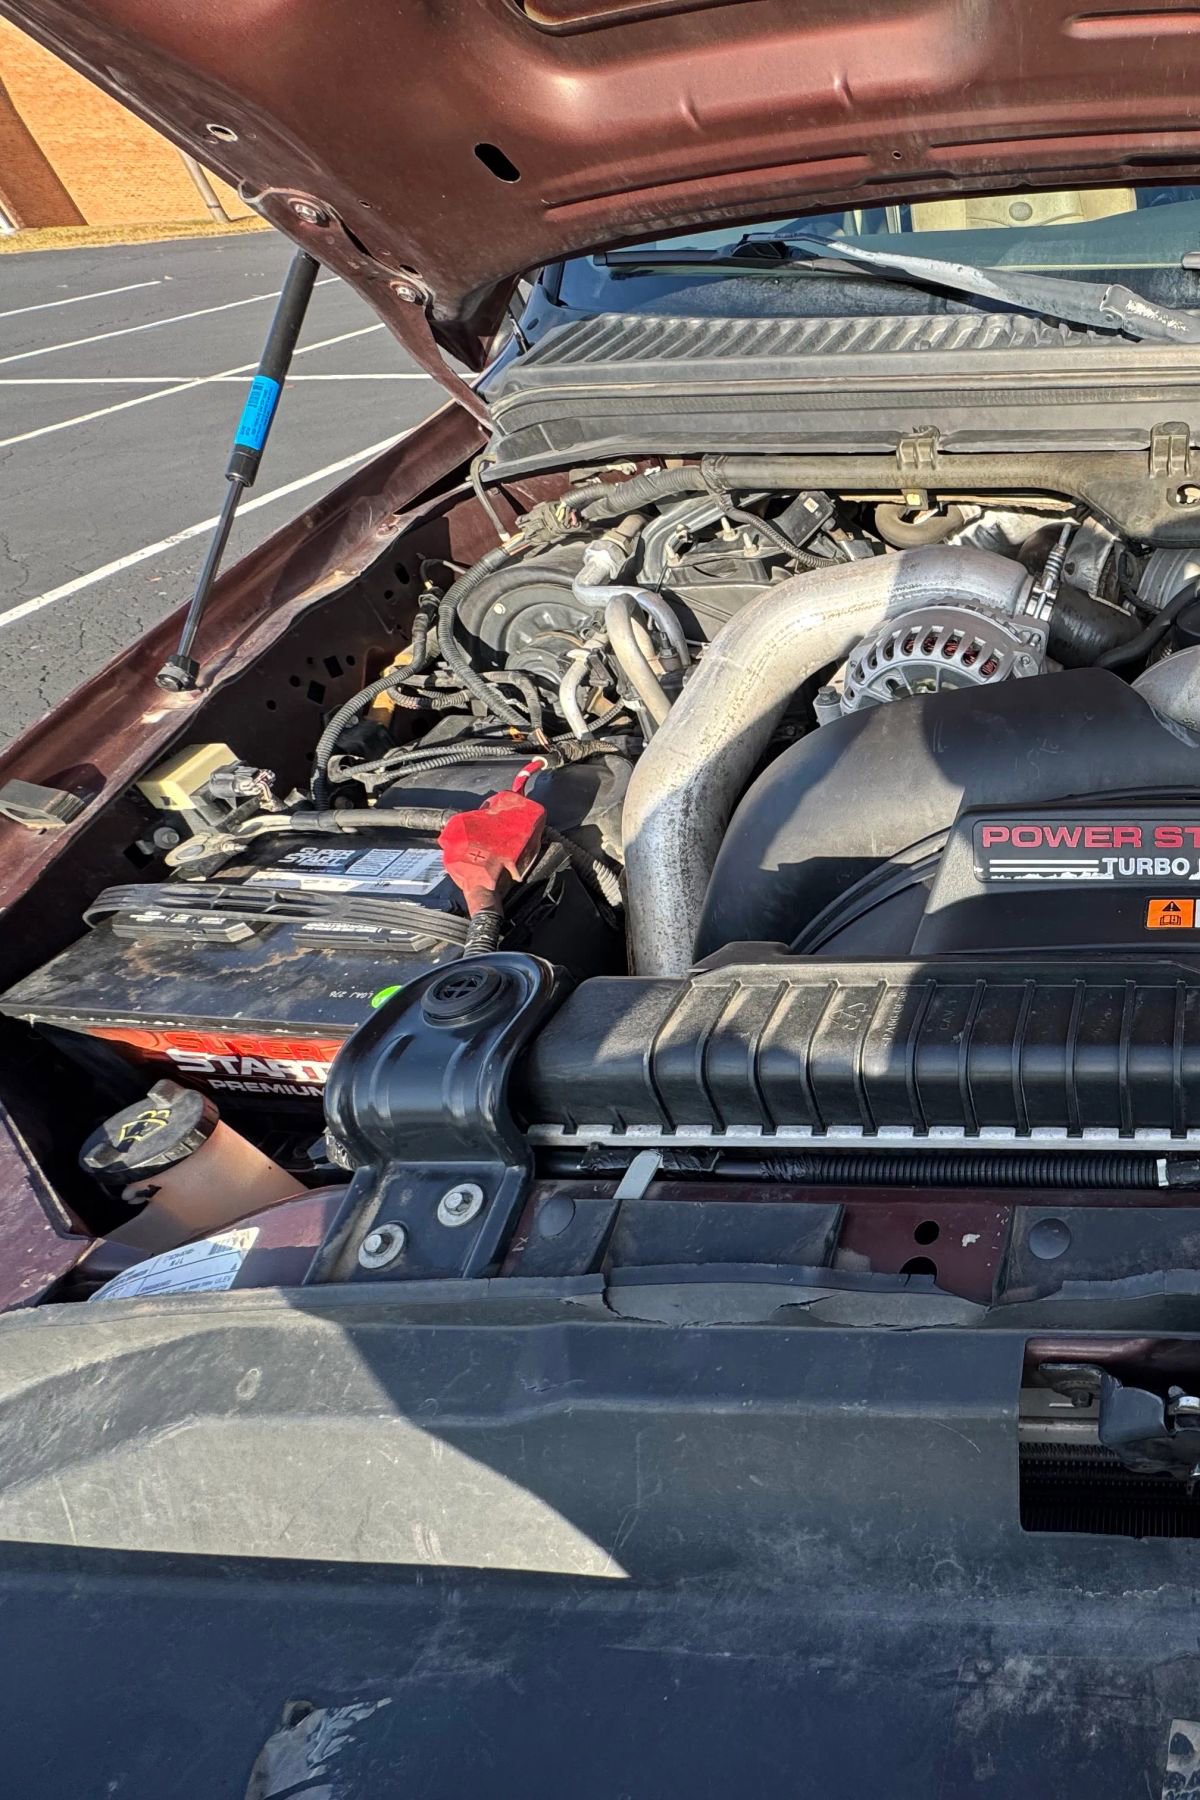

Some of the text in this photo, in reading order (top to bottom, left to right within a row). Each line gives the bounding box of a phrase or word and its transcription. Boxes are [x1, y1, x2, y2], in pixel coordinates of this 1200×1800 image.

[982, 826, 1142, 849] POWER
[278, 853, 346, 864] START
[1102, 857, 1190, 876] TURBO
[165, 1032, 327, 1062] SUPER
[166, 1049, 334, 1083] START
